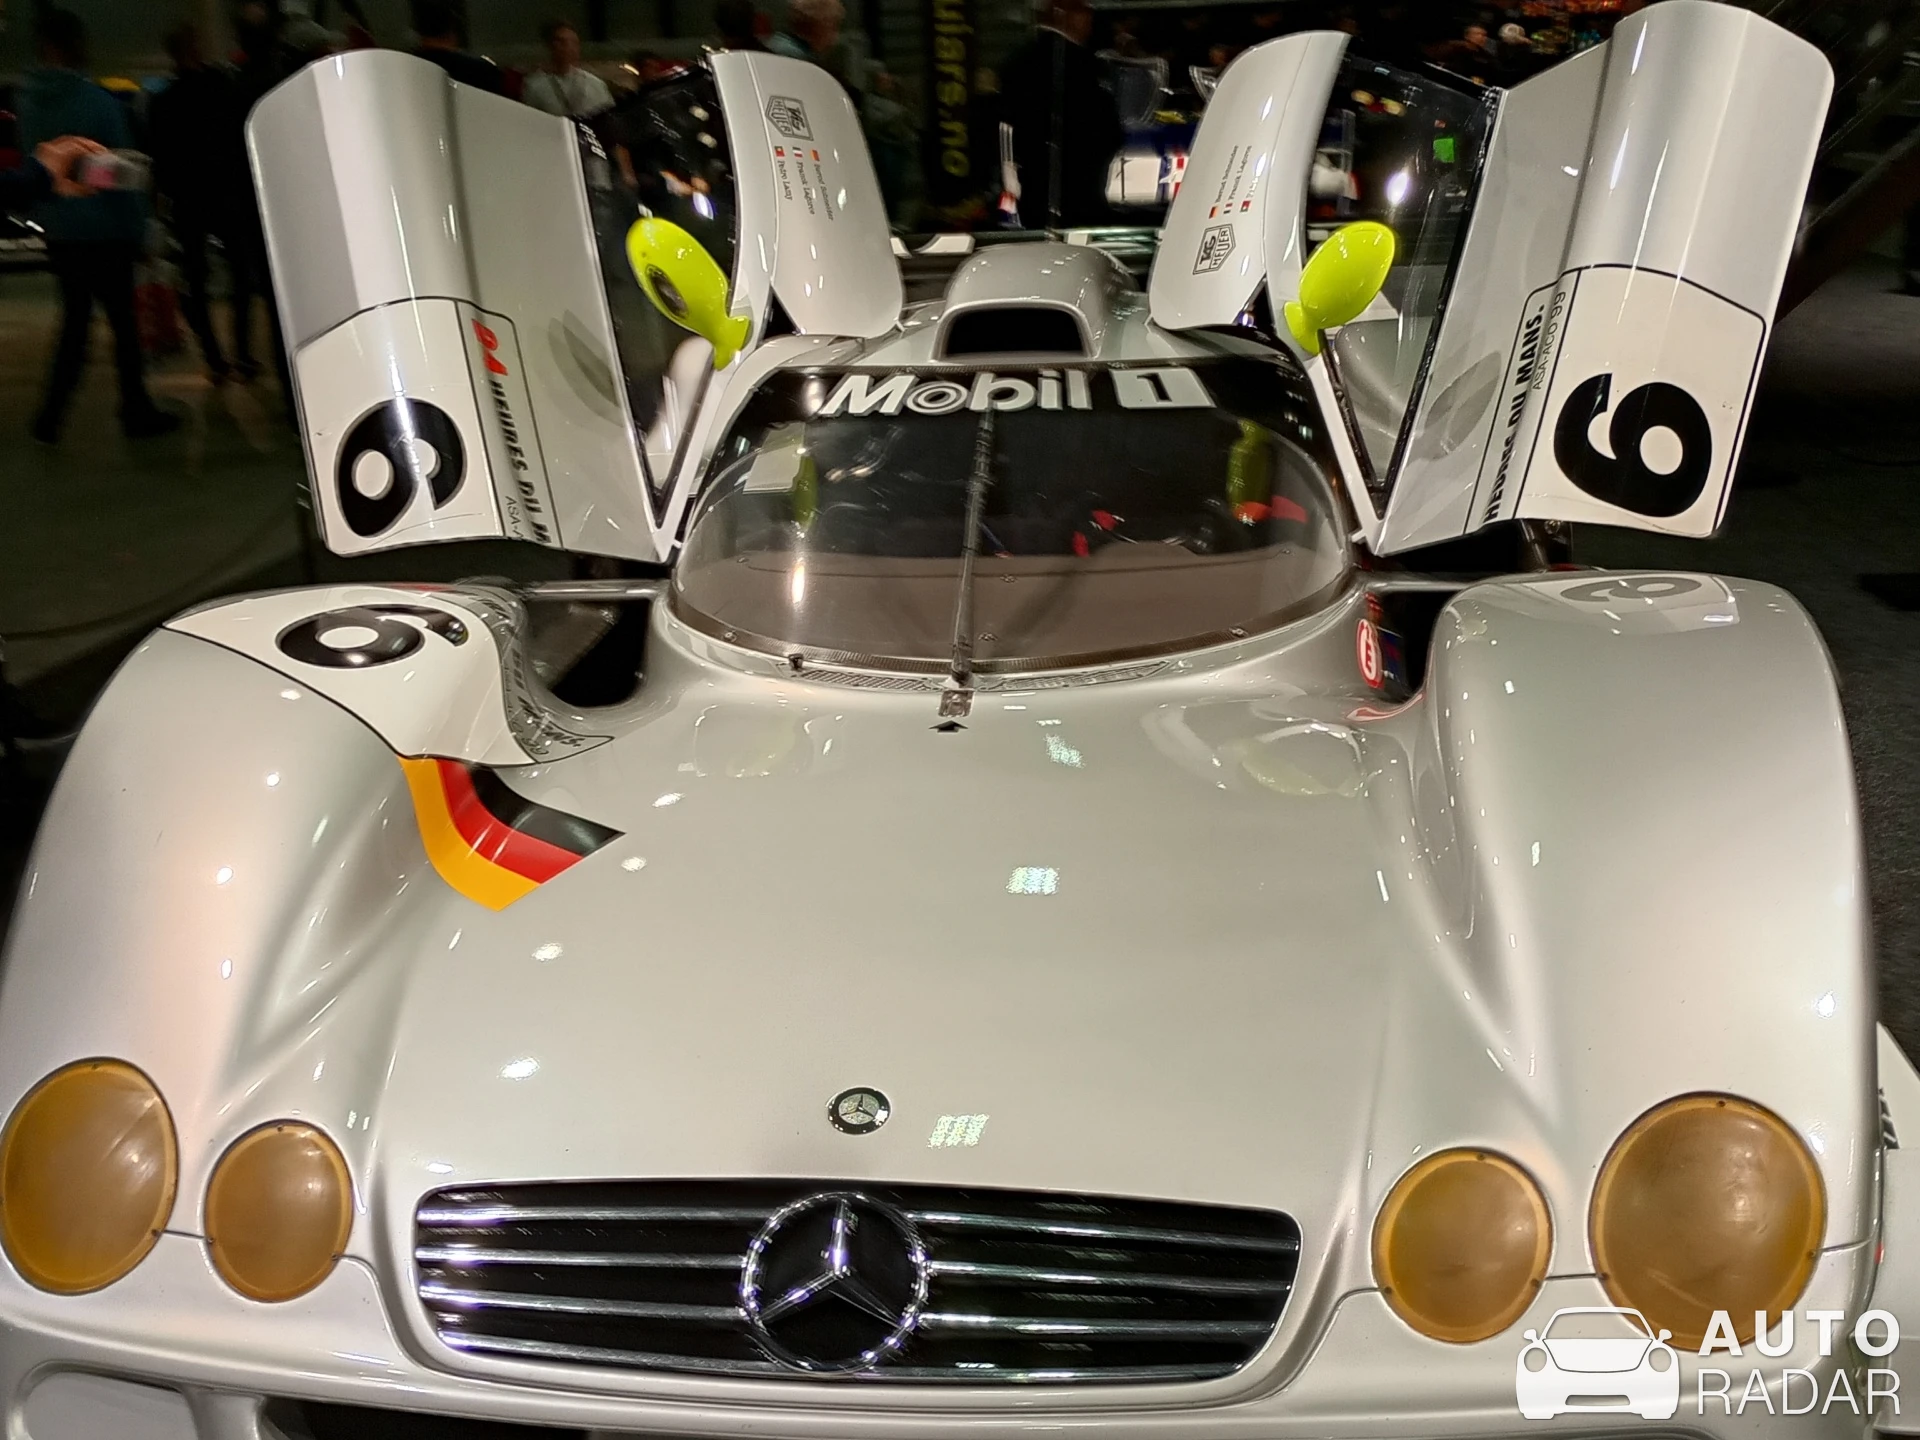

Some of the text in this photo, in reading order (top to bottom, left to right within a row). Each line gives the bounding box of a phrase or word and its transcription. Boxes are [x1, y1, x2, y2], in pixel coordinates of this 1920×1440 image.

[771, 101, 791, 133] HEUER
[1199, 235, 1217, 265] TAG
[1212, 229, 1230, 267] HEUER
[1531, 322, 1559, 390] ASA-ACO
[489, 379, 529, 472] HEURES
[817, 369, 1092, 416] Mobil
[1484, 304, 1545, 522] HEURES DU MANS.
[334, 398, 468, 538] 6
[1554, 373, 1712, 517] 6
[275, 603, 469, 669] 6
